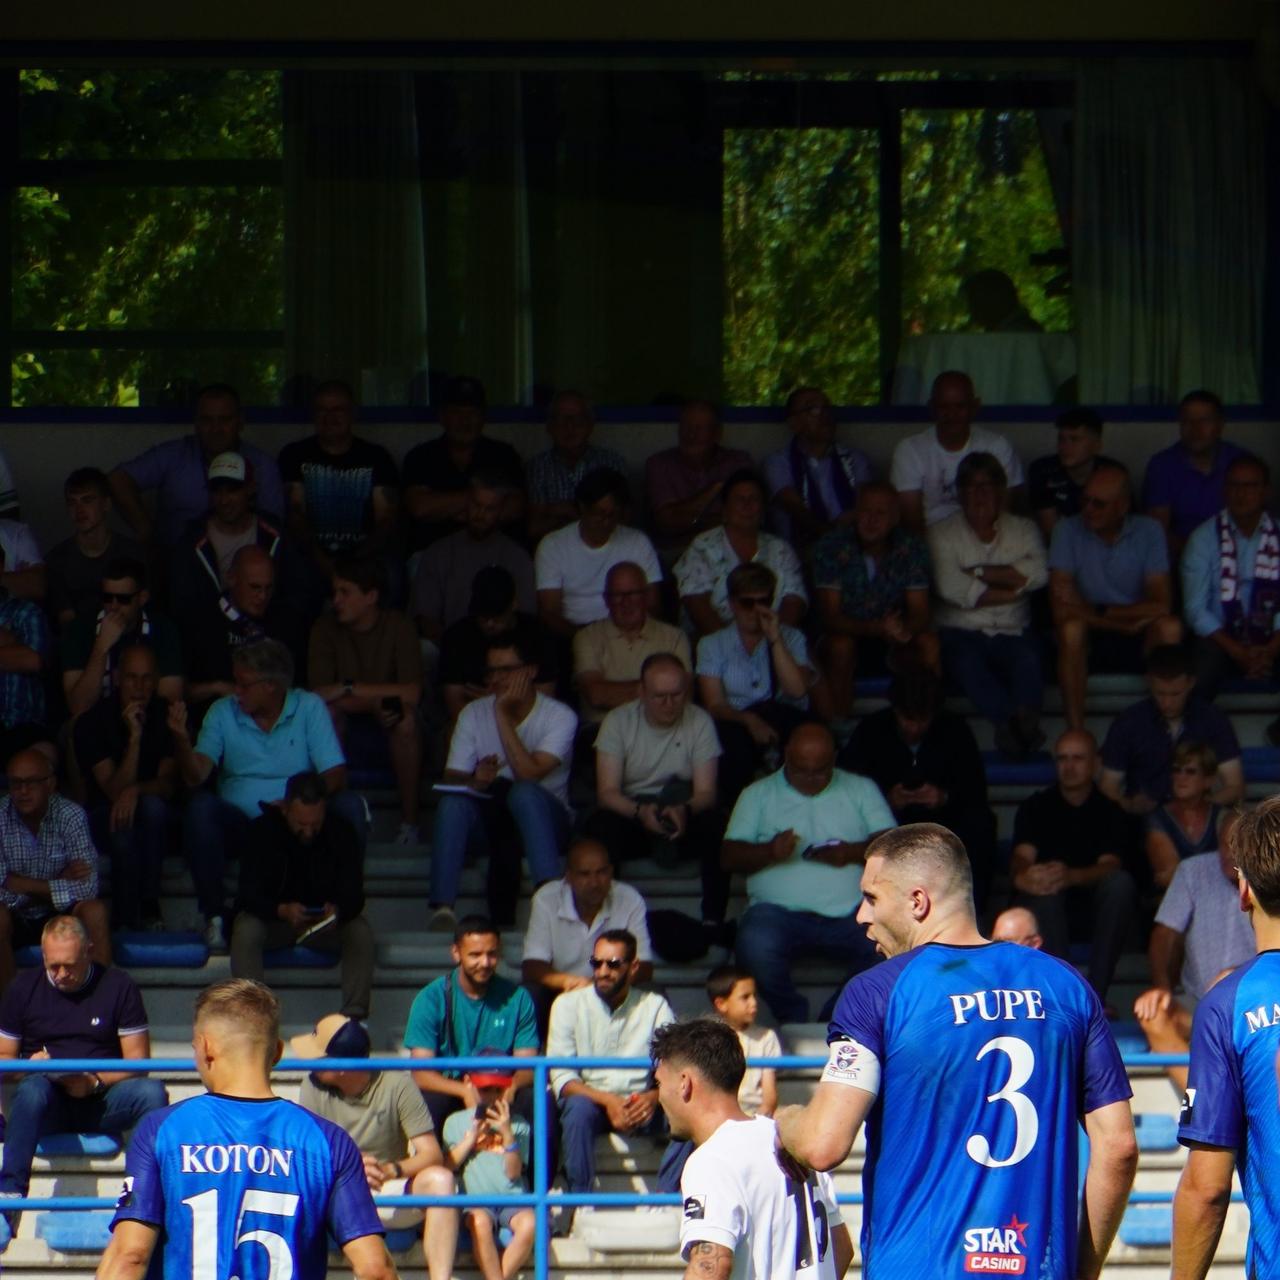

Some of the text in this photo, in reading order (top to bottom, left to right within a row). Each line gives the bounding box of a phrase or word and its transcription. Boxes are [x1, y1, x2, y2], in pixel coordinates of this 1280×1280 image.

[950, 990, 1046, 1025] PUPE
[966, 1036, 1039, 1168] 3
[181, 1144, 293, 1177] KOTON
[964, 1228, 1021, 1254] STAR
[970, 1256, 1021, 1271] CASINO
